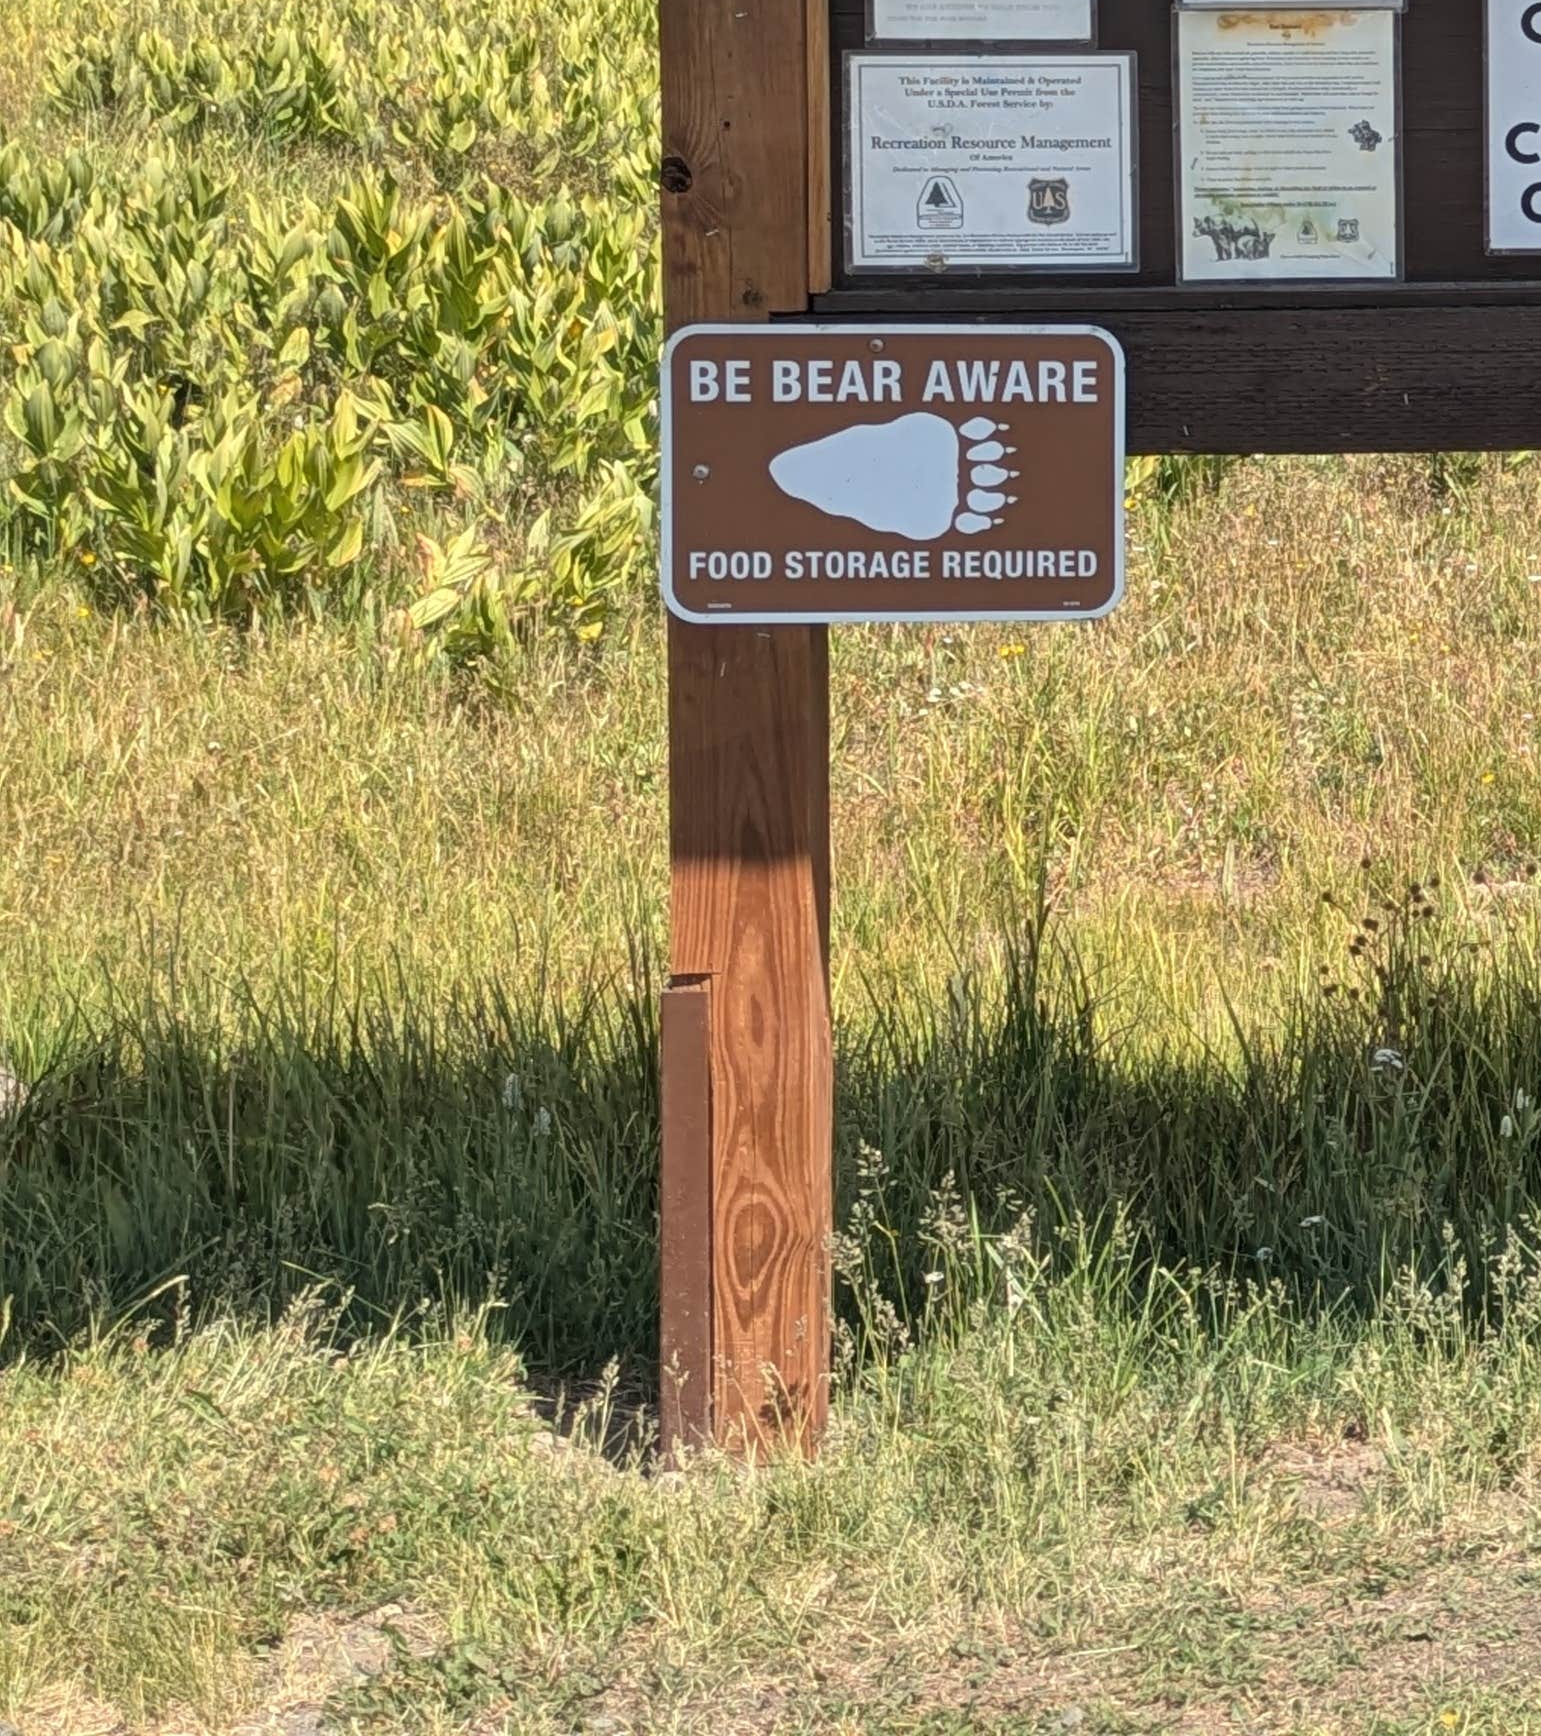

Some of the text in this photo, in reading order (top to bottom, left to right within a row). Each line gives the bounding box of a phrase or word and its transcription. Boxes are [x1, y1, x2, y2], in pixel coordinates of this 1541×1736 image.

[898, 76, 1081, 87] This Facility is Maintained & Operated
[905, 89, 935, 97] Under
[944, 88, 978, 98] Special
[980, 89, 998, 97] Use
[1000, 88, 1033, 97] Permit
[1035, 88, 1058, 97] from
[1060, 88, 1076, 97] the
[928, 100, 1054, 110] U.S.D.A. Forest Service by:
[871, 135, 1112, 153] Recreation Resource Management
[969, 154, 1014, 162] Of America
[689, 359, 1098, 403] BE BEAR AWARE
[689, 550, 1097, 581] FOOD STORAGE REQUIRED
